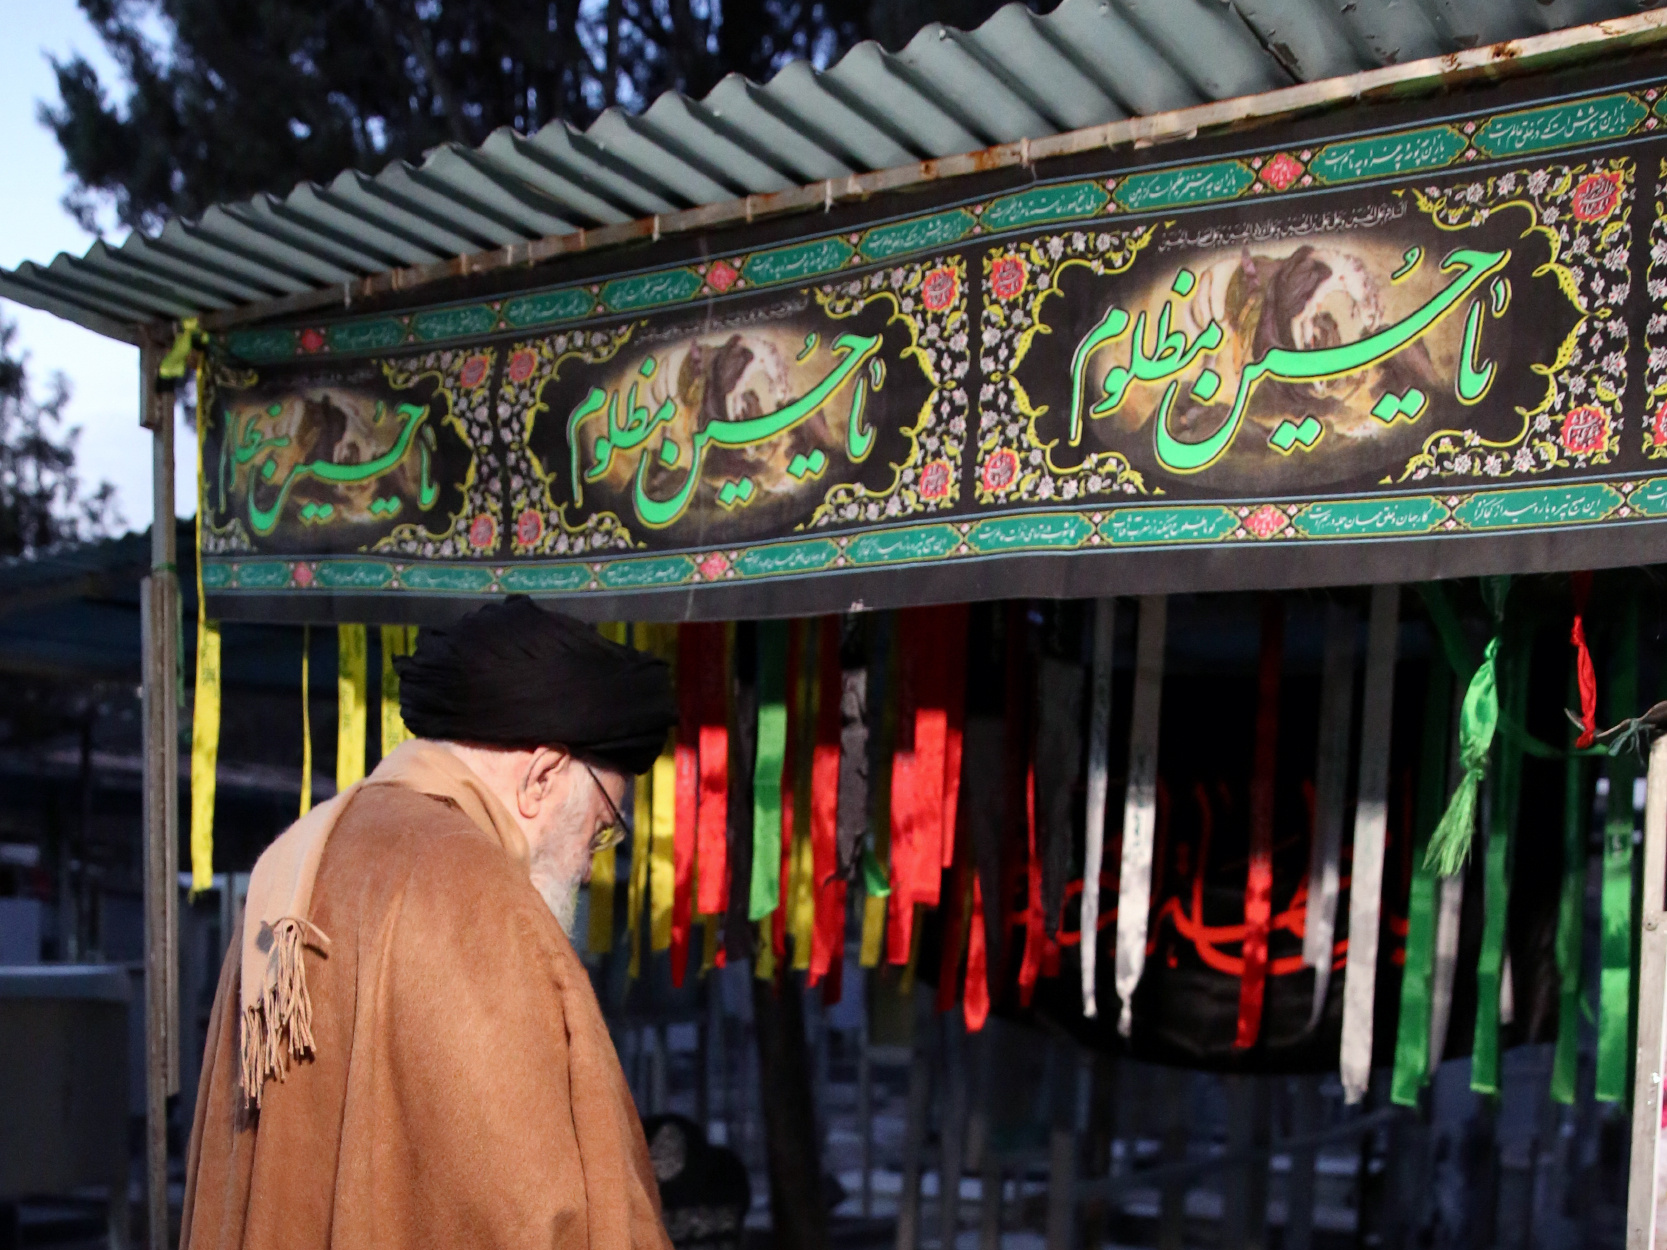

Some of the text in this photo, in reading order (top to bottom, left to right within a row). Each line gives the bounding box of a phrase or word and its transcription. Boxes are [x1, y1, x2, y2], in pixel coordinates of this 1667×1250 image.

[567, 356, 678, 508] مظلوم
[633, 331, 884, 531] حسین
[1069, 266, 1226, 448] مظلوم
[1155, 246, 1513, 474] حسین
[248, 402, 429, 537] حسین
